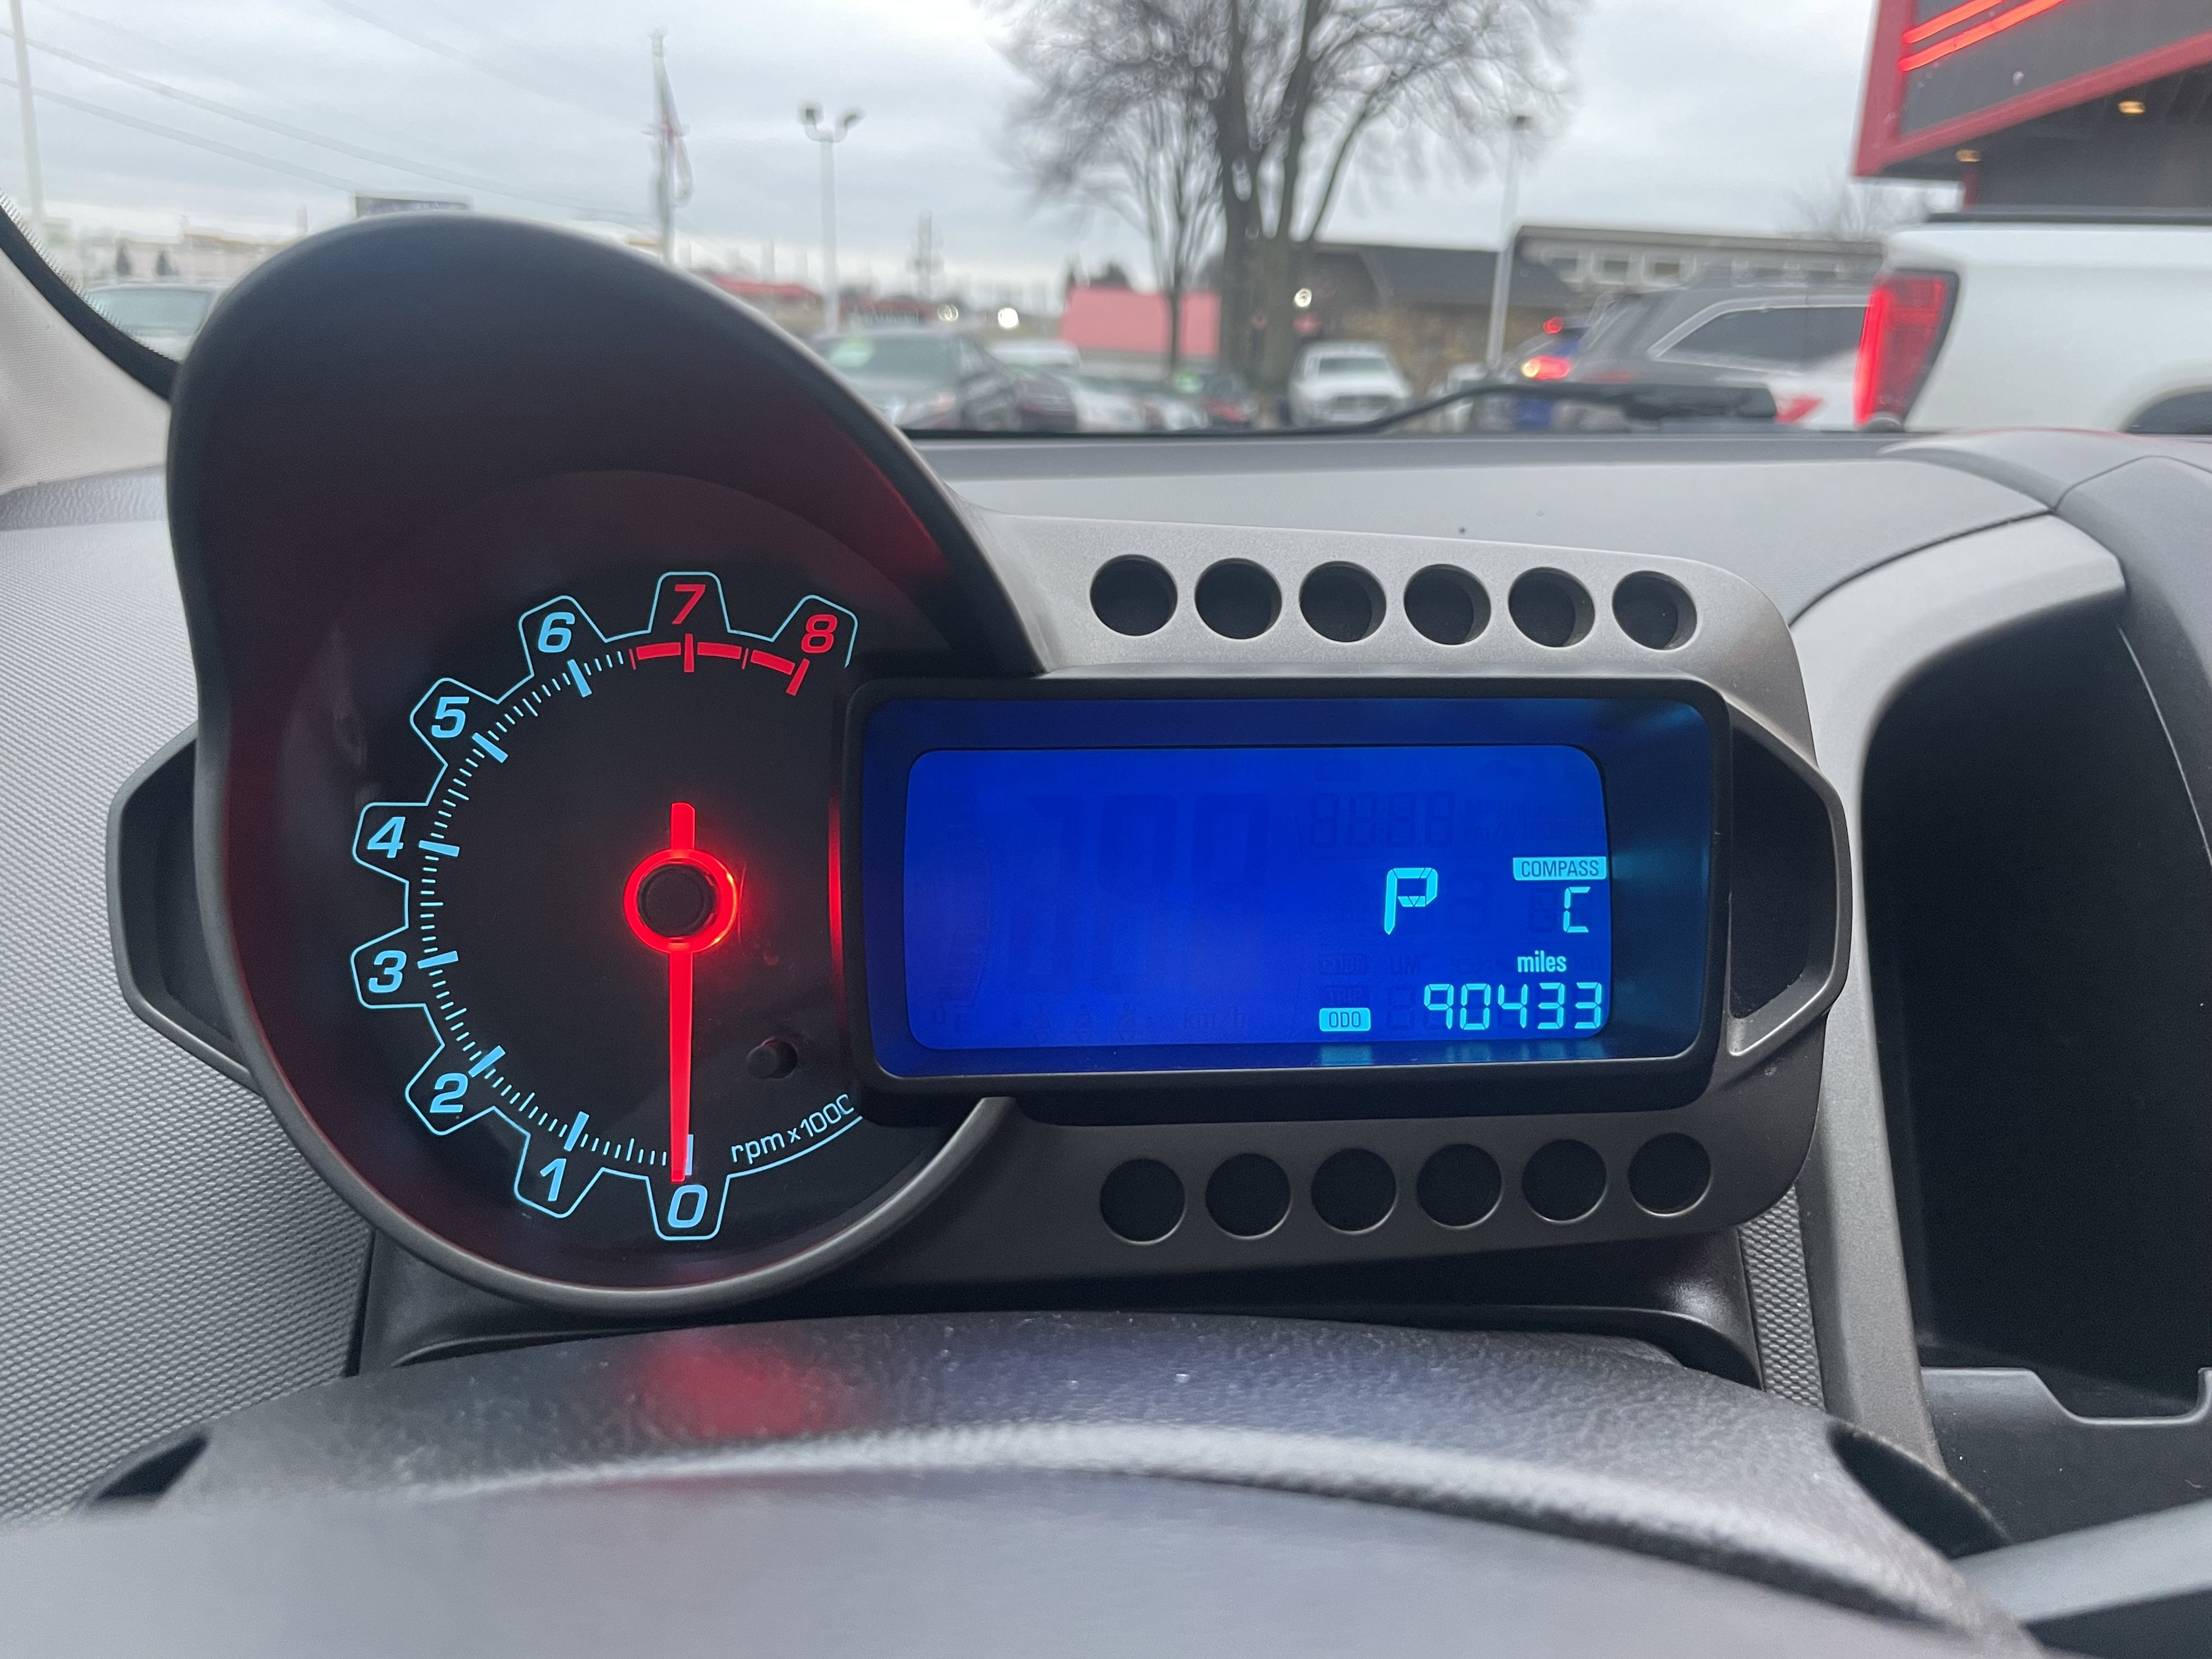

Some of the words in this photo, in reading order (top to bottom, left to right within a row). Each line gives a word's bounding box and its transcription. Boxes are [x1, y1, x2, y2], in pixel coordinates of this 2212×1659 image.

[672, 584, 706, 624] 7
[538, 612, 575, 653] 6
[800, 614, 838, 653] 8
[431, 697, 470, 738] 5
[367, 816, 406, 858] 4
[1521, 860, 1599, 877] COMPASS
[1384, 867, 1438, 934] P
[1562, 887, 1591, 933] C
[368, 950, 407, 993] 3
[1517, 950, 1567, 973] miles
[1328, 1011, 1362, 1028] ODO
[1424, 982, 1602, 1030] 90433
[430, 1073, 469, 1113] 2
[731, 1132, 785, 1164] rpm
[540, 1158, 567, 1201] 1
[668, 1184, 708, 1228] 0
